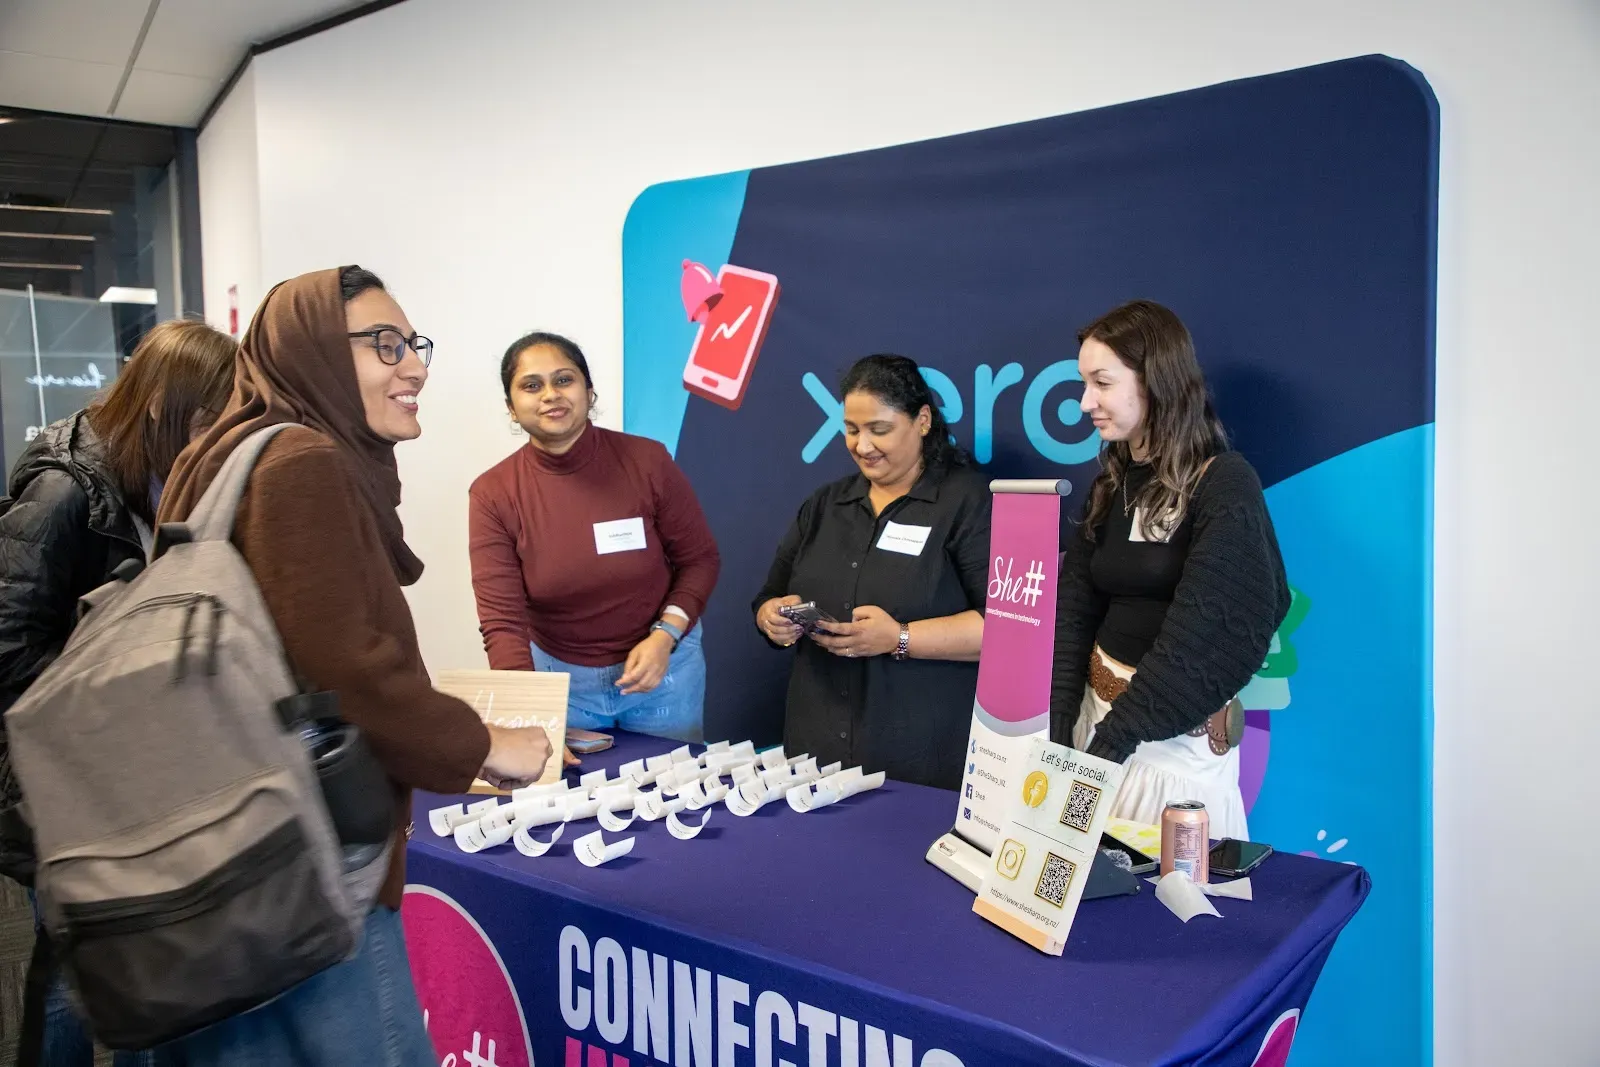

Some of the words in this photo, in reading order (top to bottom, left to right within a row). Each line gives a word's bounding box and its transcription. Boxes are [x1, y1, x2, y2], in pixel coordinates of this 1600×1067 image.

[988, 556, 1045, 607] She#
[1041, 750, 1061, 768] Let's
[1062, 759, 1077, 773] get
[558, 924, 967, 1067] CONNECT
